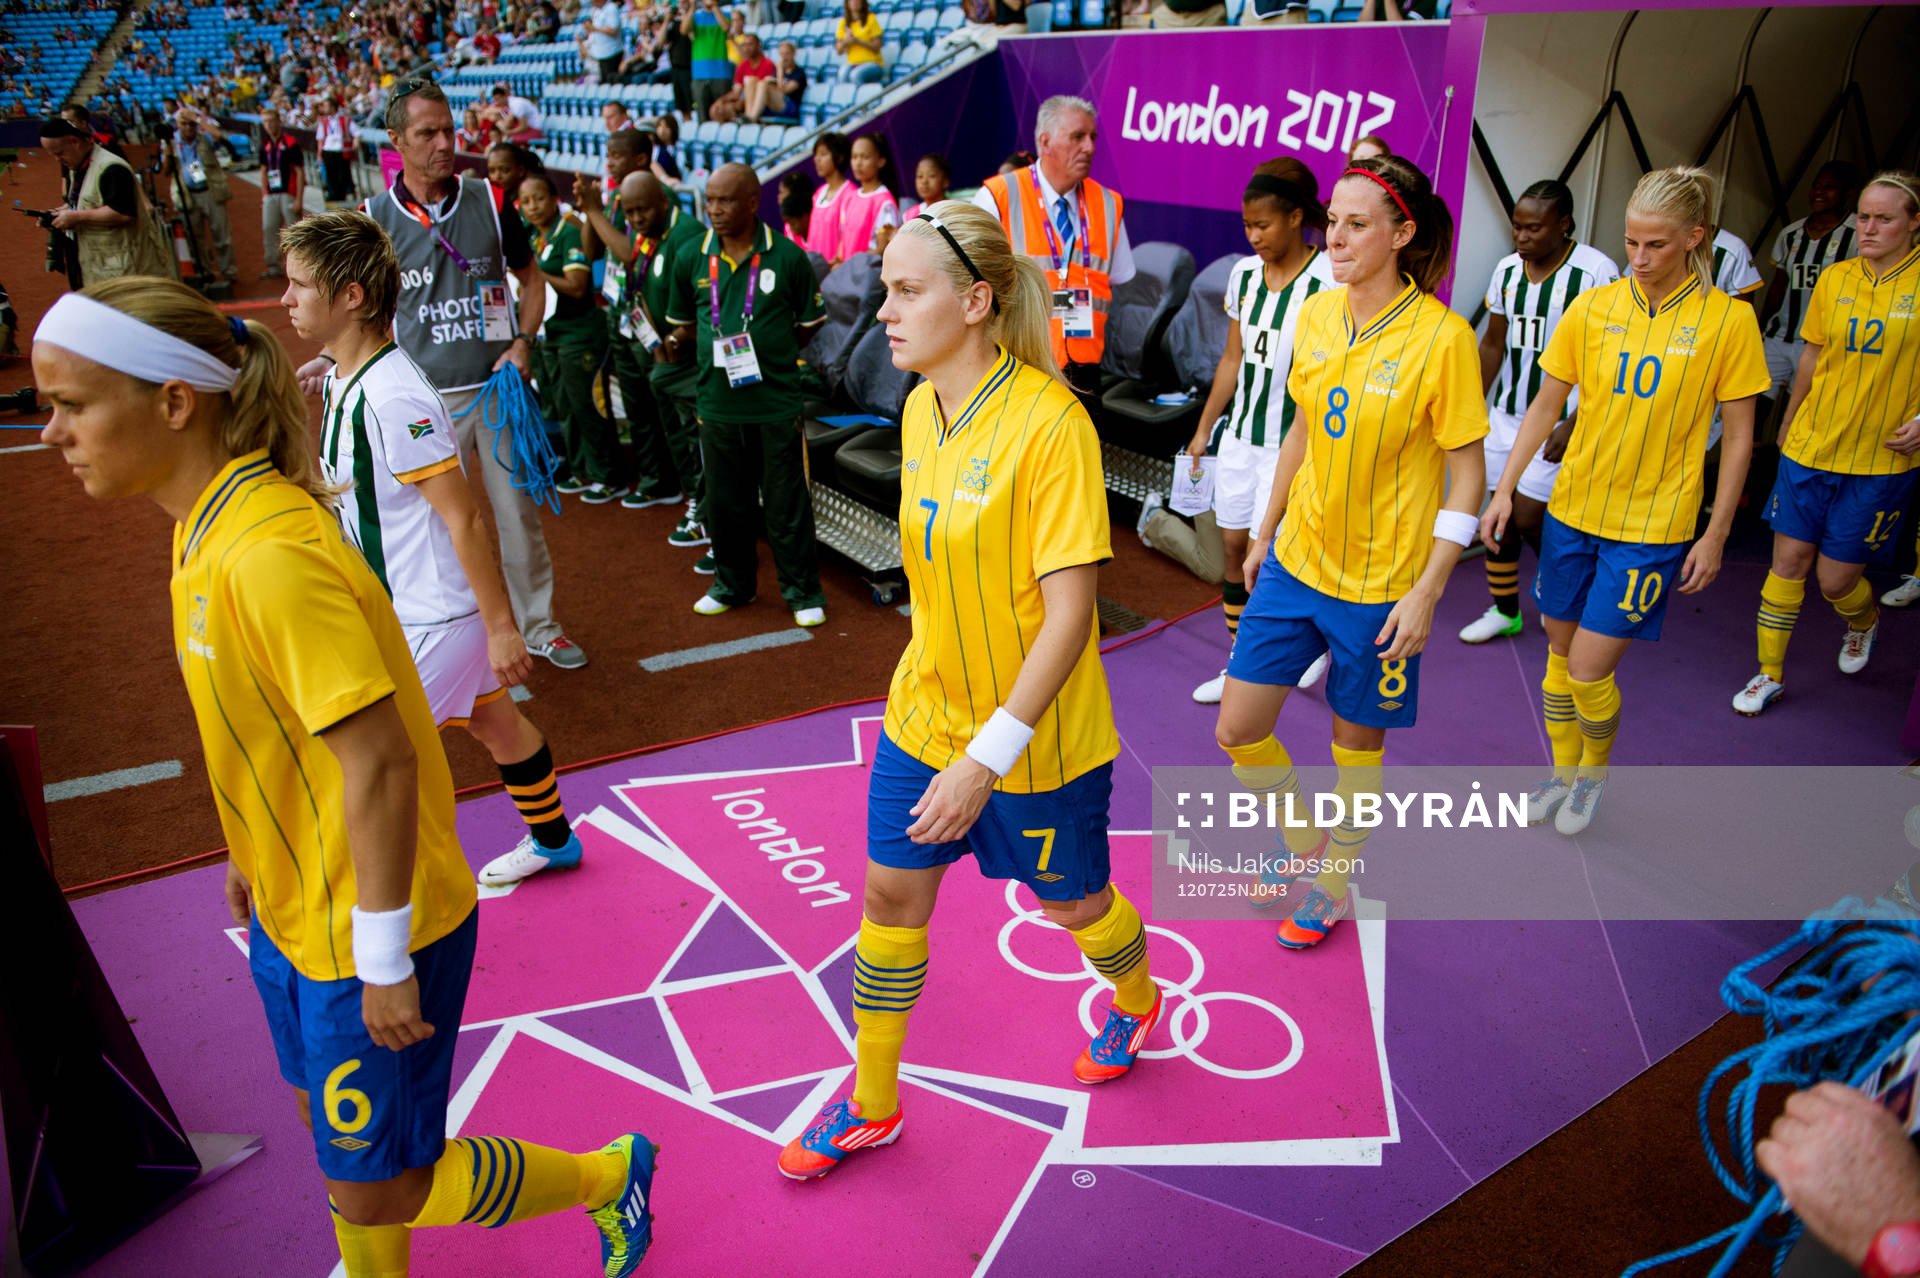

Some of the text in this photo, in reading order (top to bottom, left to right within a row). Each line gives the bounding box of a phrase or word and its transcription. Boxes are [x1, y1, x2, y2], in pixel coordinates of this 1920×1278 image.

[1121, 84, 1397, 154] London 2012
[1795, 265, 1818, 289] 15
[1254, 330, 1269, 364] 4
[1517, 317, 1541, 349] 11
[1666, 347, 1698, 357] SWE
[1845, 317, 1884, 355] 12
[1364, 384, 1400, 399] SWE
[1612, 352, 1663, 399] 10
[1324, 386, 1350, 439] 8
[953, 489, 991, 506] SWE
[919, 497, 939, 562] 7
[1864, 510, 1900, 543] 12
[1617, 568, 1663, 613] 10
[1378, 657, 1408, 698] 8
[711, 787, 852, 908] london
[1022, 828, 1057, 871] 7
[323, 1058, 372, 1134] 6
